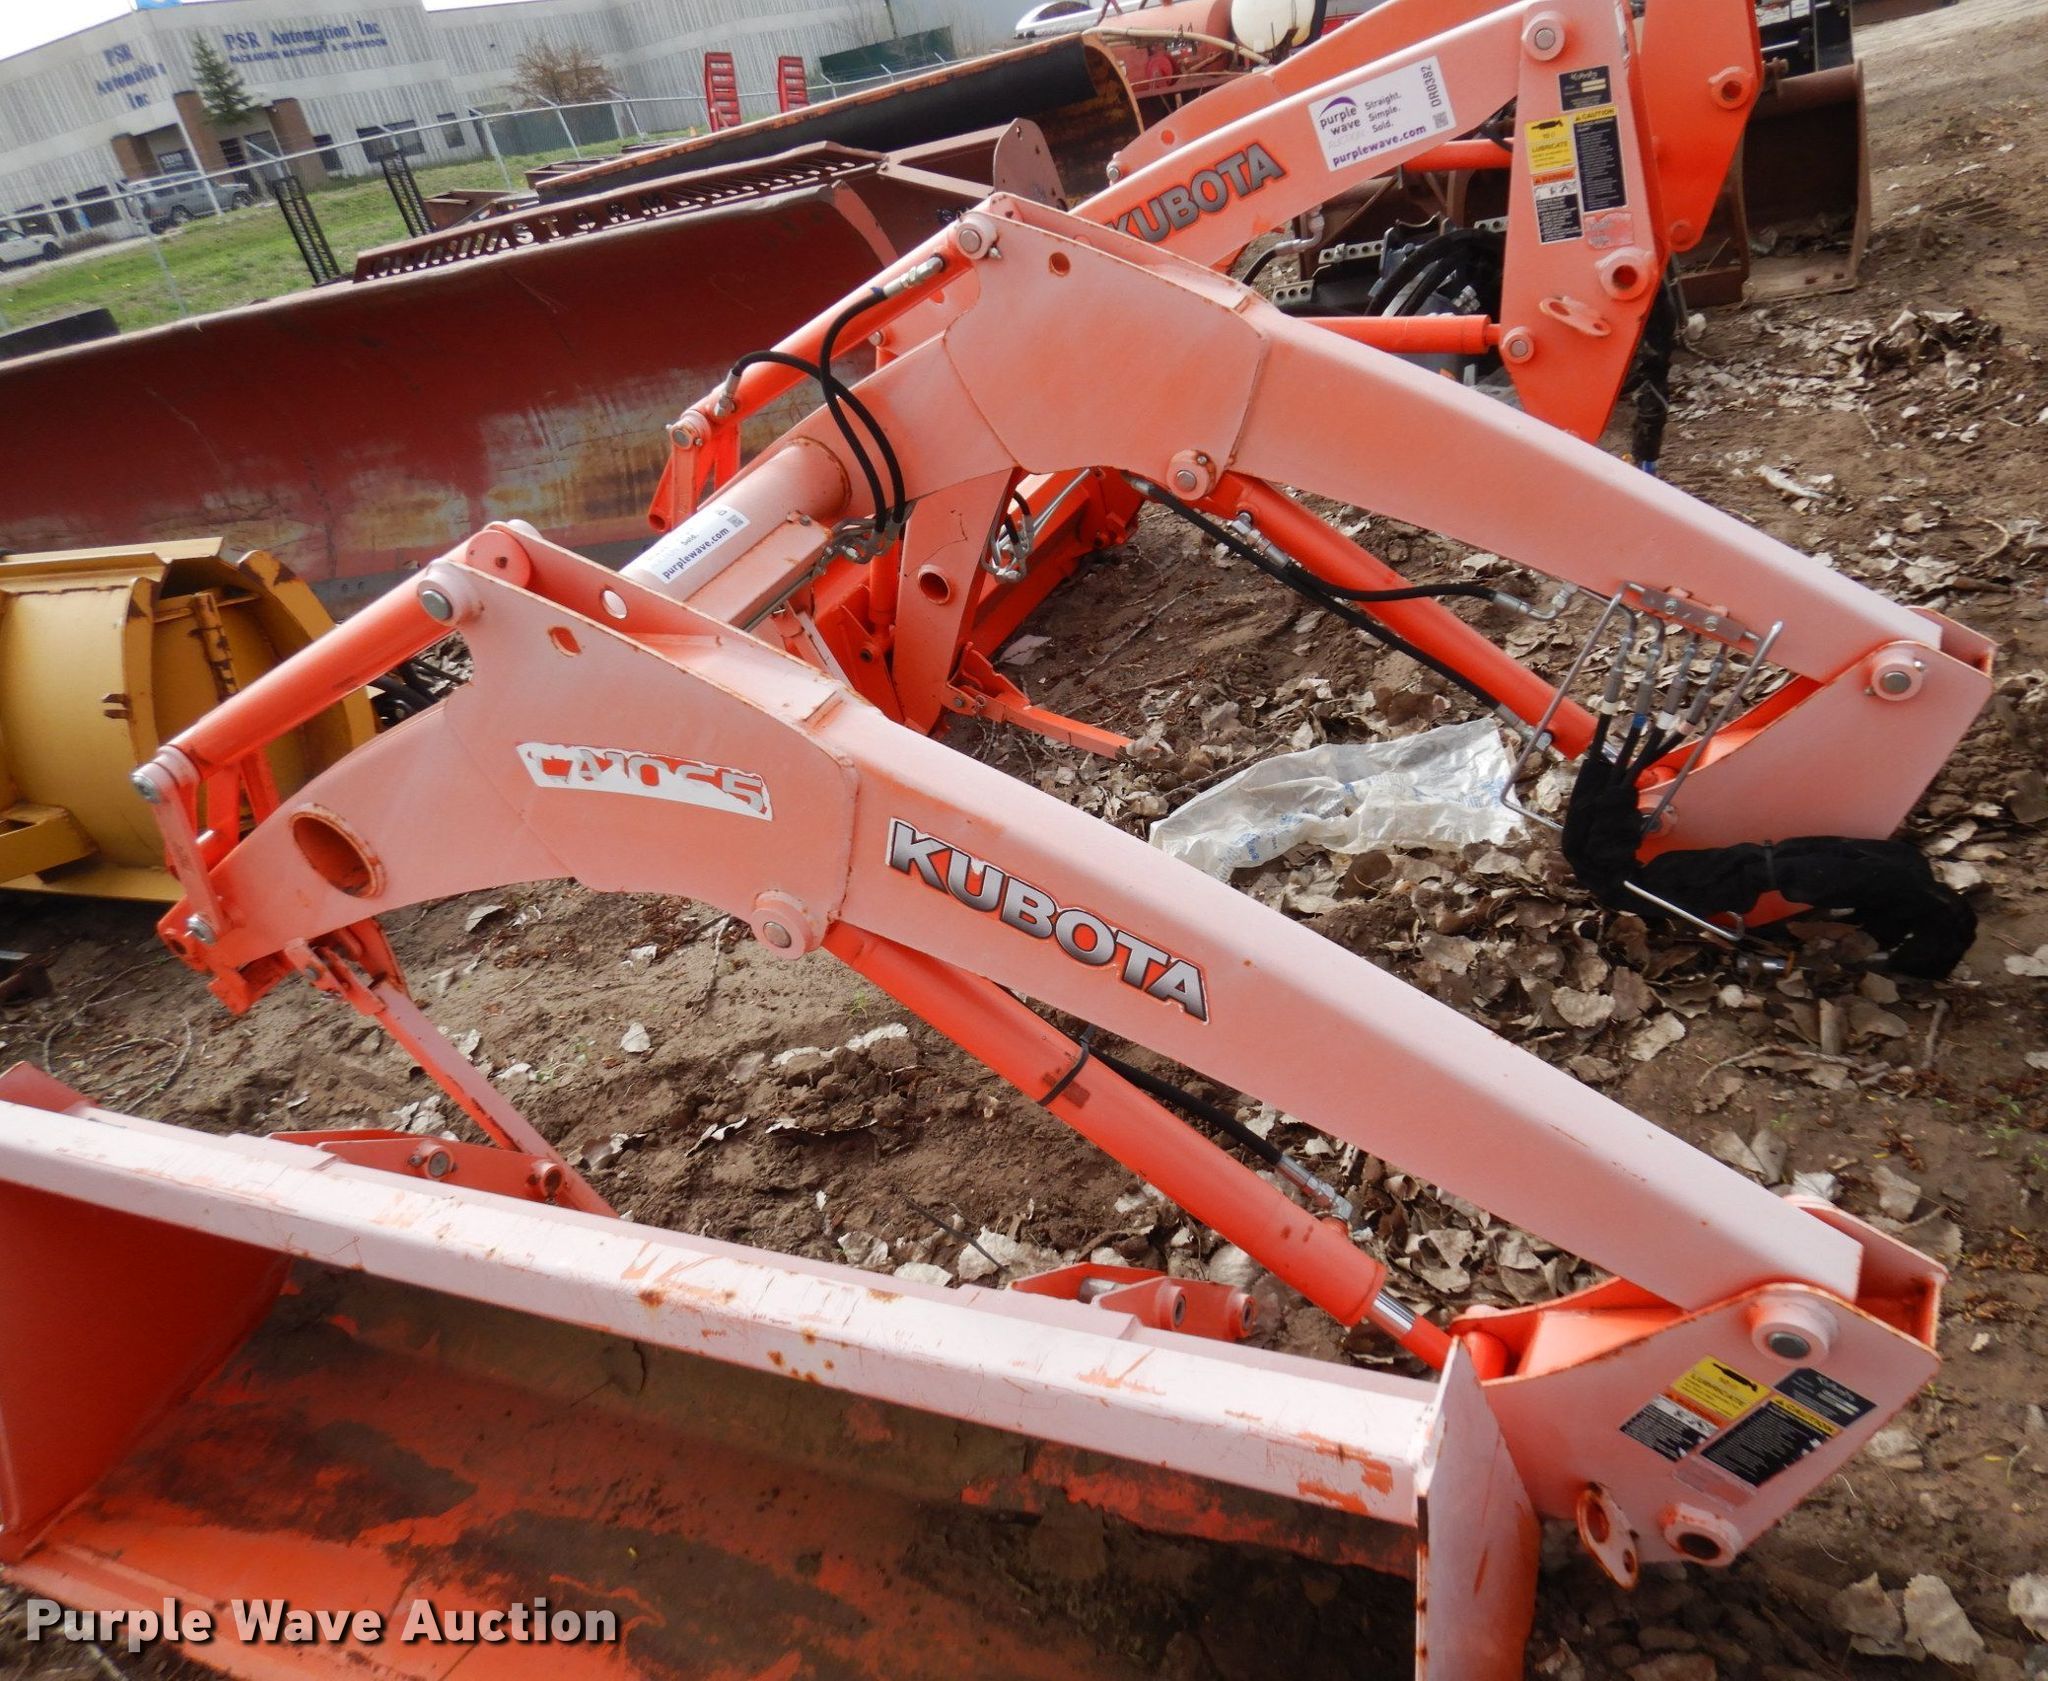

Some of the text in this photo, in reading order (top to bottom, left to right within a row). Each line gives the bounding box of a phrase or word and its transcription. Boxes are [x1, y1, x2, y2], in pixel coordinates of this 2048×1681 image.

[224, 20, 380, 49] PSR Automation Inc
[103, 45, 134, 67] PSR
[126, 93, 151, 110] Inc
[1364, 91, 1403, 111] Straight.
[1320, 106, 1358, 130] purple
[1368, 104, 1401, 122] Simple.
[1330, 118, 1361, 136] wave
[1372, 120, 1394, 133] Sold.
[1332, 125, 1427, 167] purplewave.com
[661, 526, 730, 580] purplewave.com
[888, 818, 1209, 1023] KUBOTA
